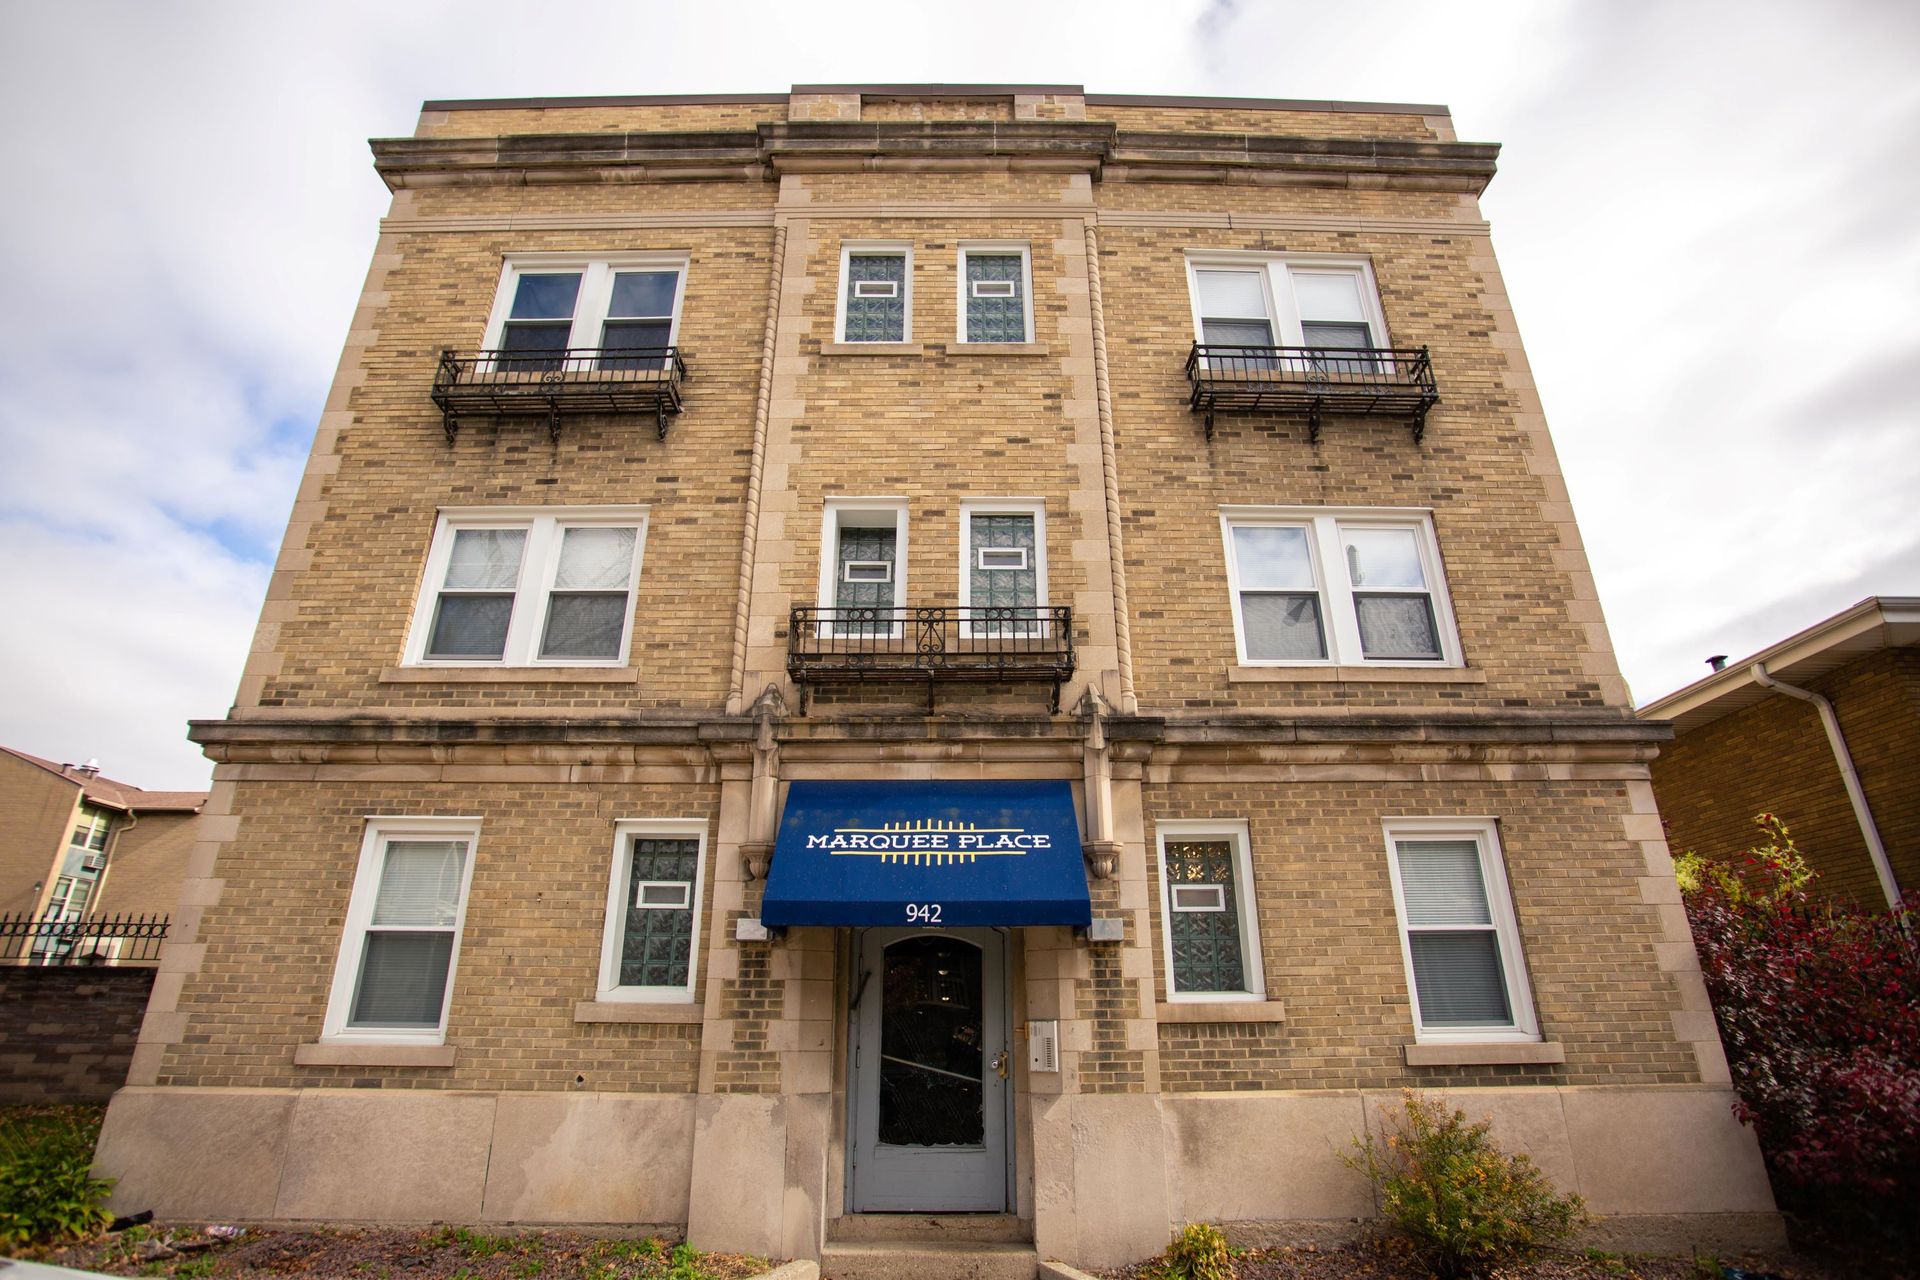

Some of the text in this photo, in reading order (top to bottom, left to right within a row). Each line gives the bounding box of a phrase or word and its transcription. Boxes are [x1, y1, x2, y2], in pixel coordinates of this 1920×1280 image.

[806, 834, 1052, 849] MARQUEE PLACE
[905, 903, 942, 923] 942
